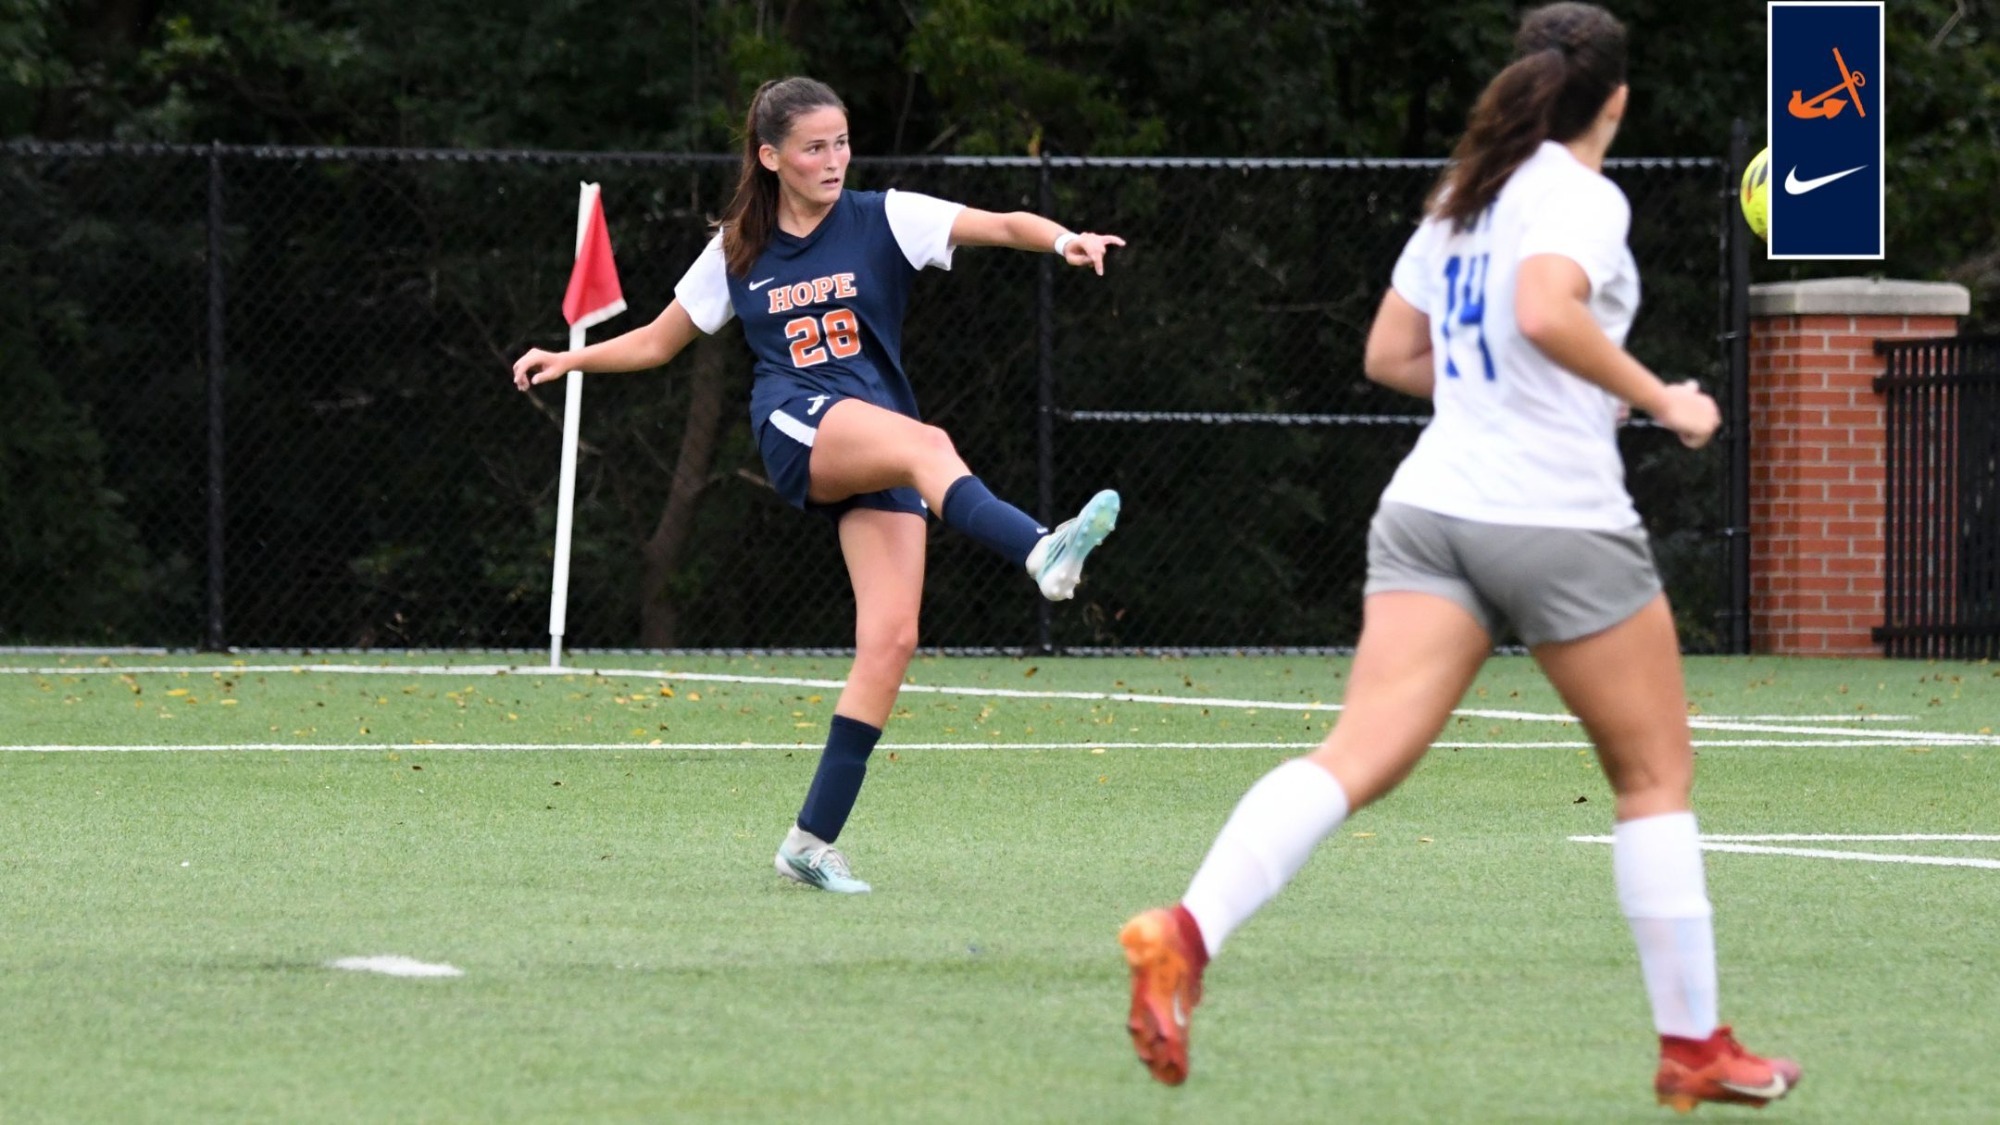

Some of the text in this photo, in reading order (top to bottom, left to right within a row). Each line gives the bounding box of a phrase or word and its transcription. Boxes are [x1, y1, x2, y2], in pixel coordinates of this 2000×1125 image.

[768, 272, 857, 314] HOPE
[1442, 253, 1496, 381] 14
[785, 308, 861, 368] 28
